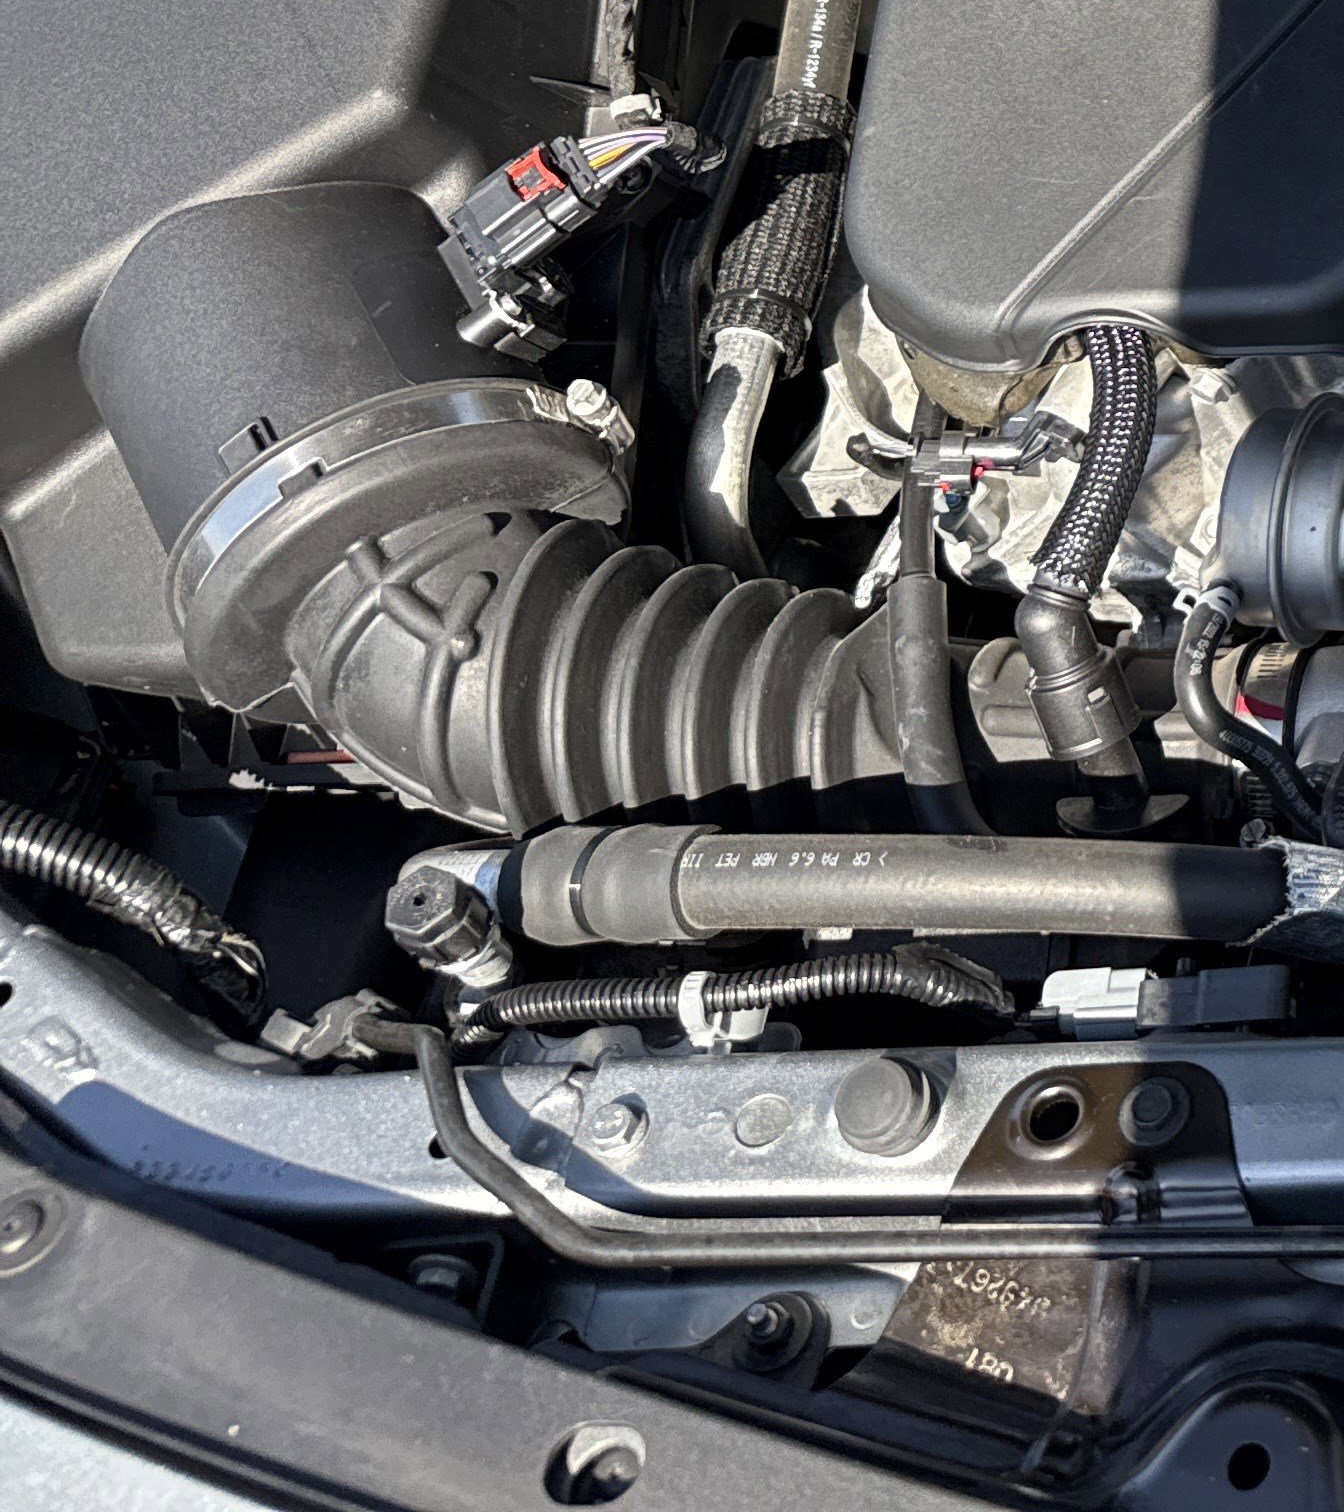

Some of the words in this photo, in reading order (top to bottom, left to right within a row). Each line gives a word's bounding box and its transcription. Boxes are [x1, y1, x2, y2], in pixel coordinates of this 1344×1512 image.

[714, 852, 741, 868] PET
[788, 851, 816, 868] 6.6
[821, 852, 841, 867] PA
[852, 852, 872, 867] CR
